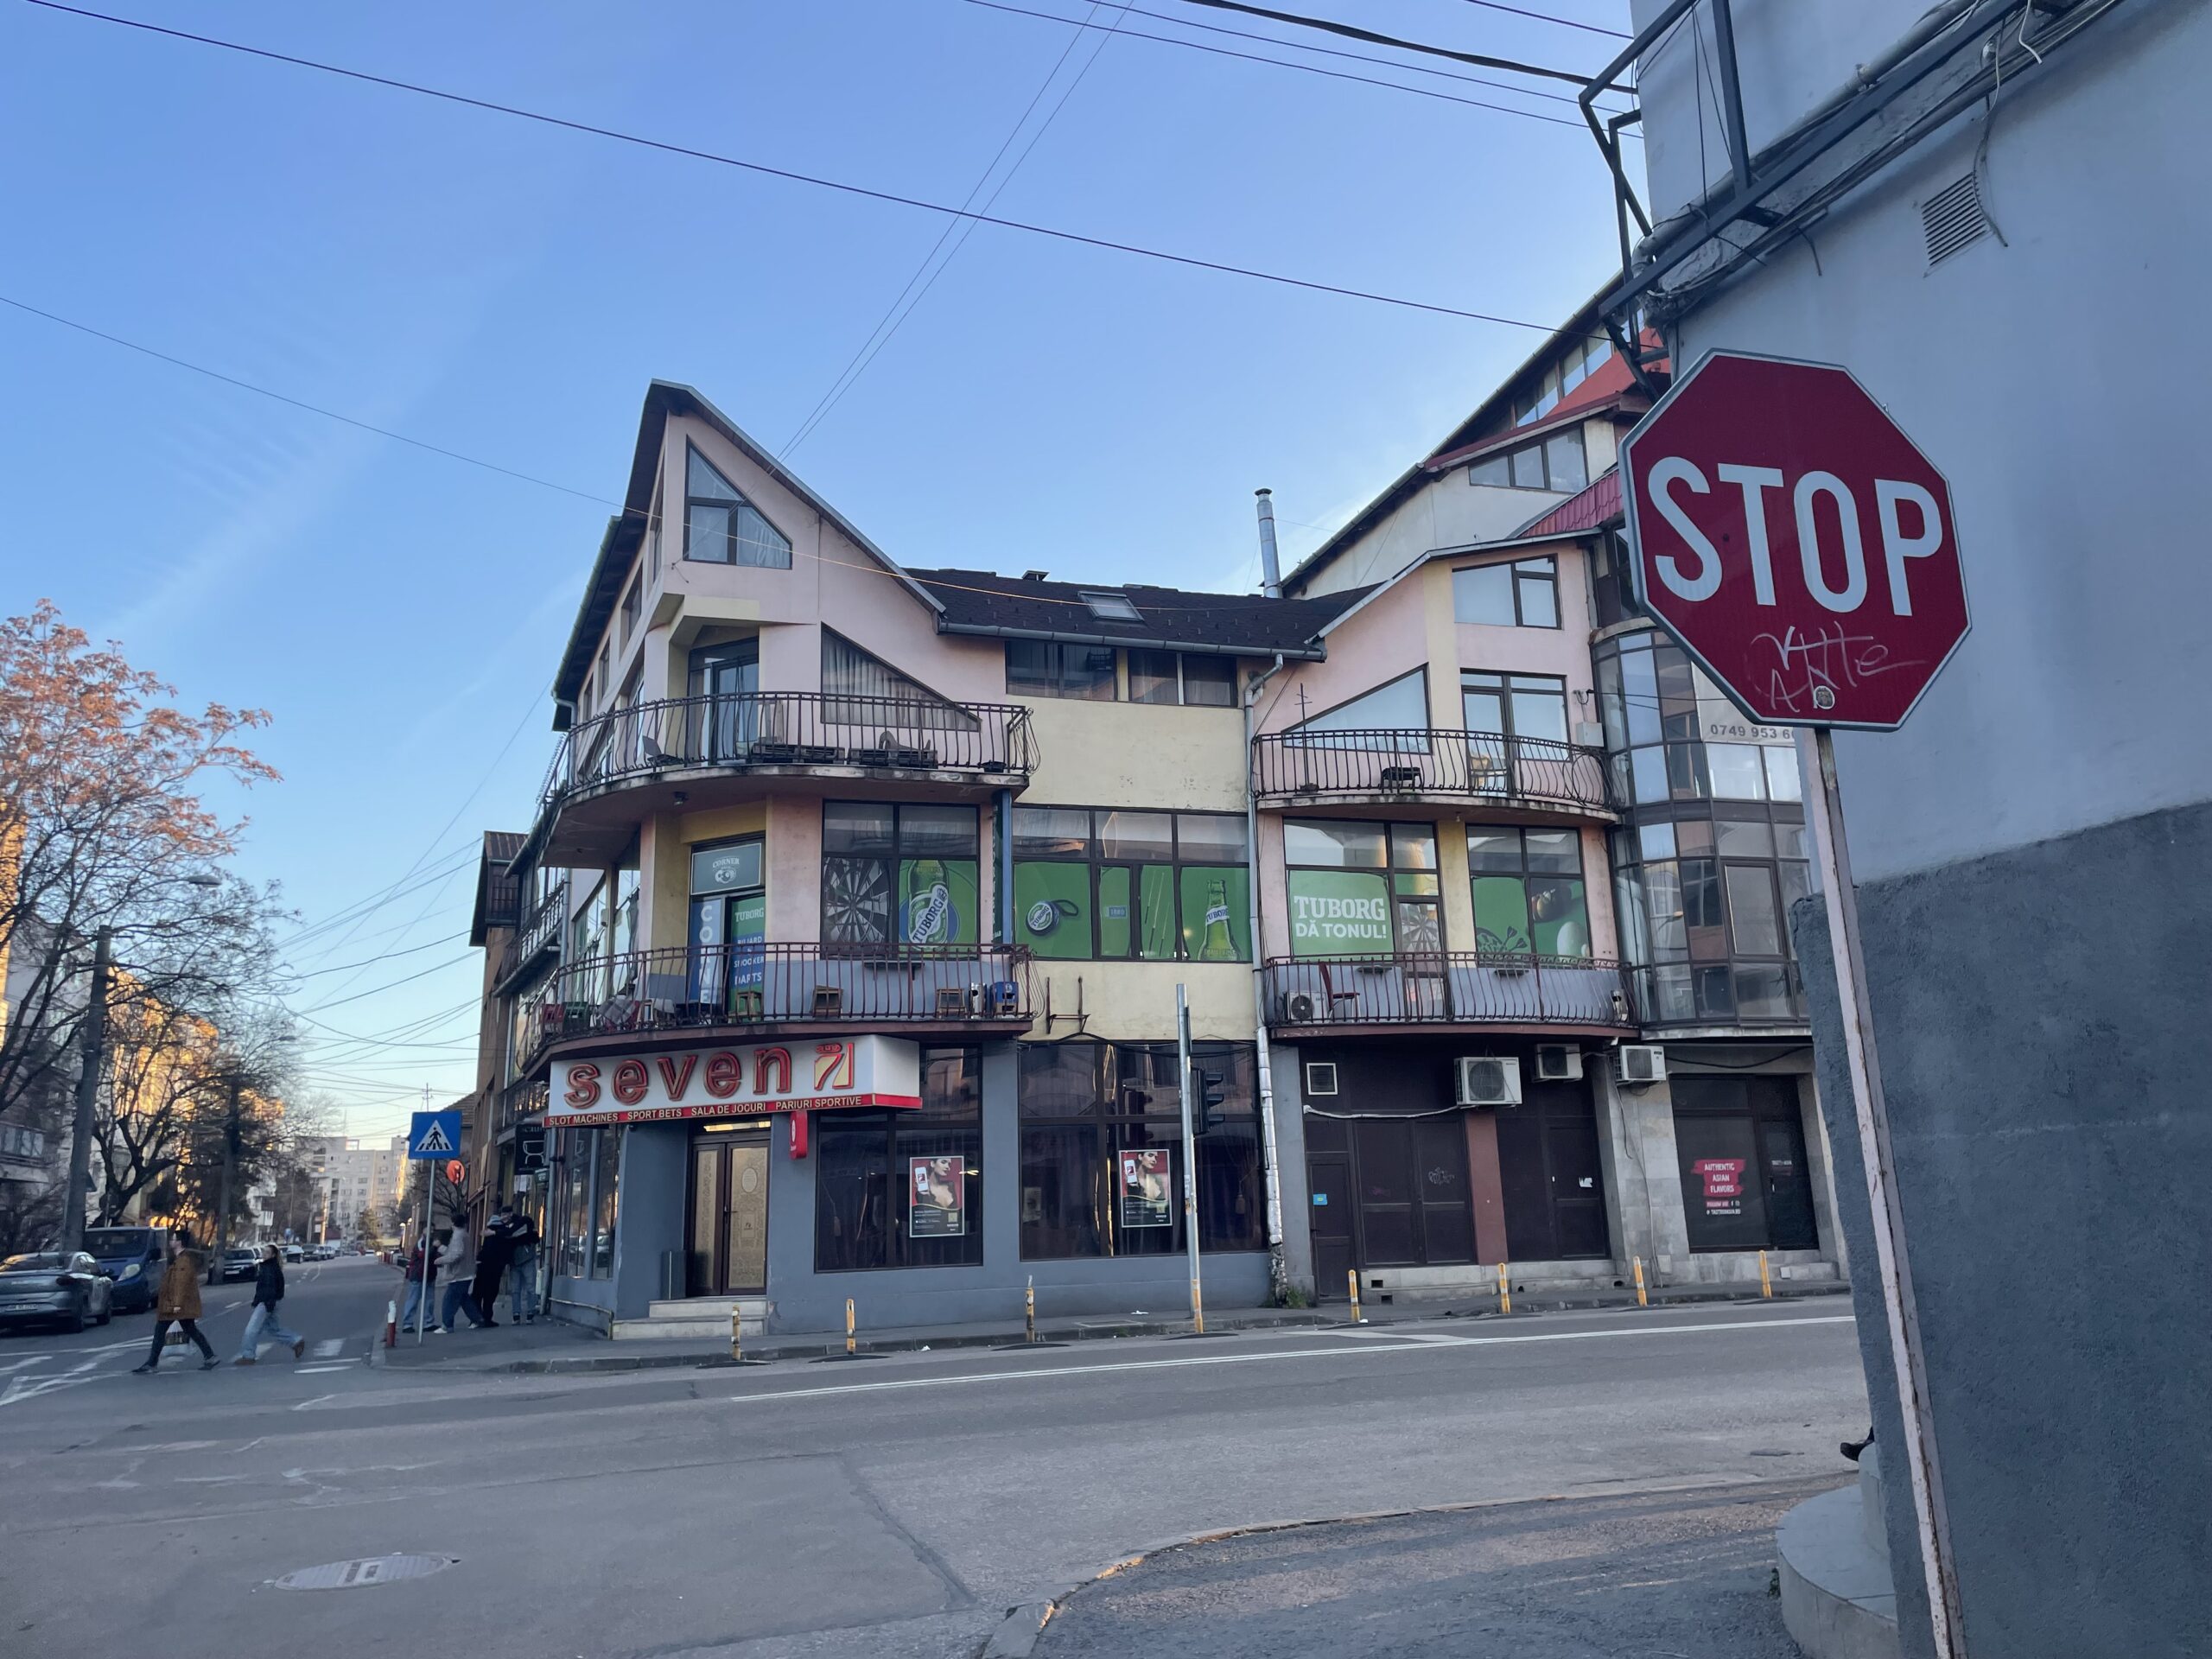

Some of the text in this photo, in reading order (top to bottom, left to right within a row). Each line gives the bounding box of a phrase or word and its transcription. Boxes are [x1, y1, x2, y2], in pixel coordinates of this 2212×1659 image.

[1647, 456, 1943, 617] STOP
[1710, 724, 1745, 737] 0749
[1751, 727, 1777, 739] 953
[712, 857, 740, 868] CORNER
[734, 907, 765, 922] TUBORG
[1033, 905, 1051, 927] TUBORG
[1293, 895, 1386, 921] TUBORG
[912, 899, 944, 943] TUBORG
[1295, 919, 1387, 939] DĂ TONUL!
[734, 955, 764, 968] SNOOKER
[734, 972, 762, 985] DARTS
[563, 1046, 792, 1109] seven
[549, 1096, 861, 1126] SLOT MACHINES SPORT BETS SALA DE JOCURI PARIURI SPORTIVE
[1704, 1162, 1735, 1172] AUTHENTIC
[1710, 1185, 1735, 1193] FLAVORS
